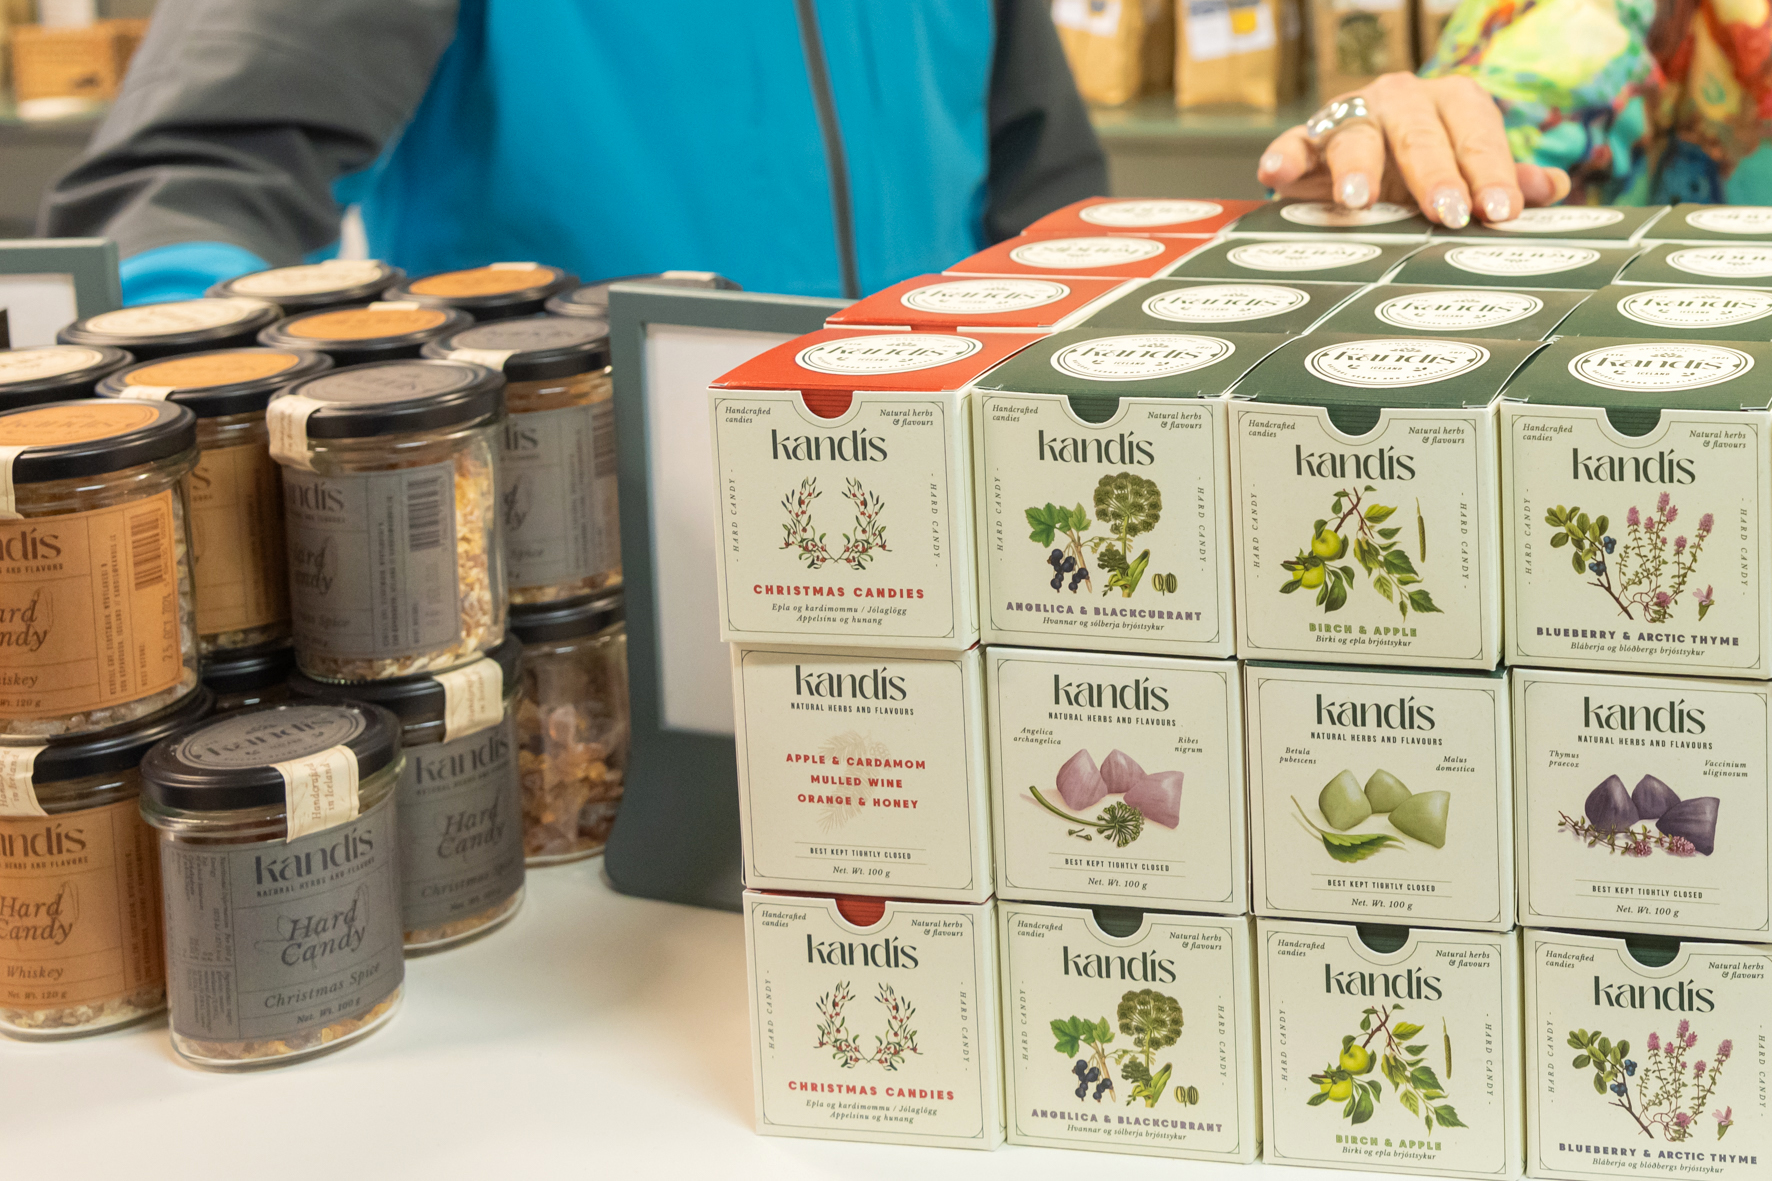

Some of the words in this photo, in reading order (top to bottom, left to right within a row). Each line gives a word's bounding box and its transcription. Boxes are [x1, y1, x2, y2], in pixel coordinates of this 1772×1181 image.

[725, 406, 771, 417] Handcrafted
[879, 409, 910, 417] Natural
[912, 409, 933, 417] herbs
[892, 418, 900, 426] &
[900, 418, 933, 428] flavours
[1522, 423, 1573, 435] Handcrafted
[1522, 433, 1552, 441] candies
[1689, 430, 1722, 438] Natural
[1724, 430, 1746, 439] herbs
[1702, 440, 1711, 448] &
[1711, 440, 1746, 450] flavours
[1523, 498, 1531, 537] CANDY
[1740, 508, 1748, 541] HARD
[1524, 543, 1532, 575] HARD
[753, 584, 845, 597] CHRISTMAS
[853, 587, 924, 599] CANDIES
[772, 603, 790, 612] Epla
[805, 604, 858, 613] kardimommu
[867, 606, 907, 616] Jólaglögg
[1006, 601, 1074, 614] ANGELICA
[1080, 606, 1087, 615] &
[1094, 607, 1202, 621] BLACKCURRANT
[796, 614, 836, 624] Appelsínu
[851, 615, 883, 626] hunang
[1043, 617, 1078, 625] Hvannar
[1090, 619, 1120, 630] sólberja
[1122, 621, 1165, 632] brjóstsykur
[1309, 623, 1352, 634] BIRCH
[1358, 625, 1367, 635] &
[1373, 626, 1417, 637] APPLE
[1537, 627, 1616, 640] BLUEBERRY
[1622, 631, 1630, 640] &
[1637, 632, 1685, 643] ARCTIC
[1691, 635, 1739, 646] THYME
[1316, 635, 1336, 643] Birki
[1349, 637, 1366, 646] epla
[1368, 637, 1412, 648] brjóstsykur
[1570, 642, 1605, 652] Bláberja
[1619, 644, 1657, 656] blóðbergs
[1660, 646, 1705, 657] brjóstsykur
[791, 702, 824, 711] NATURAL
[828, 704, 852, 713] HERBS
[856, 706, 871, 714] AND
[875, 707, 914, 716] FLAVOURS
[1020, 727, 1053, 736] Angelica
[1013, 735, 1061, 745] archangelica
[1178, 736, 1198, 744] Ribes
[1174, 745, 1203, 754] nigrum
[1285, 747, 1310, 755] Betula
[1549, 750, 1579, 759] Thymus
[786, 753, 825, 764] APPLE
[832, 756, 839, 765] &
[846, 757, 925, 769] CARDAMOM
[1279, 756, 1316, 764] pubescens
[1548, 760, 1579, 768] praecox
[1705, 759, 1746, 768] Vaccinium
[1435, 764, 1475, 772] domestica
[1703, 768, 1748, 778] uliginosum
[320, 762, 334, 798] Iceland
[811, 775, 862, 786] MULLED
[868, 778, 902, 788] WINE
[304, 762, 321, 820] Handcrafted
[328, 800, 335, 811] in
[797, 793, 852, 806] ORANGE
[858, 797, 866, 806] &
[873, 798, 918, 809] HONEY
[0, 823, 87, 857] ndís
[256, 885, 295, 898] NATURAL
[299, 877, 326, 890] HERBS
[330, 871, 345, 882] AND
[0, 893, 63, 919] Hard
[288, 898, 358, 942] Hard
[281, 925, 365, 967] Candy
[7, 965, 64, 981] Whiskey
[264, 979, 345, 1008] Christmas
[350, 962, 381, 986] Spice
[1336, 1134, 1378, 1146] BIRCH
[1384, 1138, 1393, 1147] &
[1399, 1139, 1441, 1151] APPLE
[1559, 1143, 1636, 1157] BLUEBERRY
[1643, 1149, 1651, 1158] &
[1658, 1150, 1705, 1161] ARCTIC
[1710, 1153, 1757, 1165] THYME
